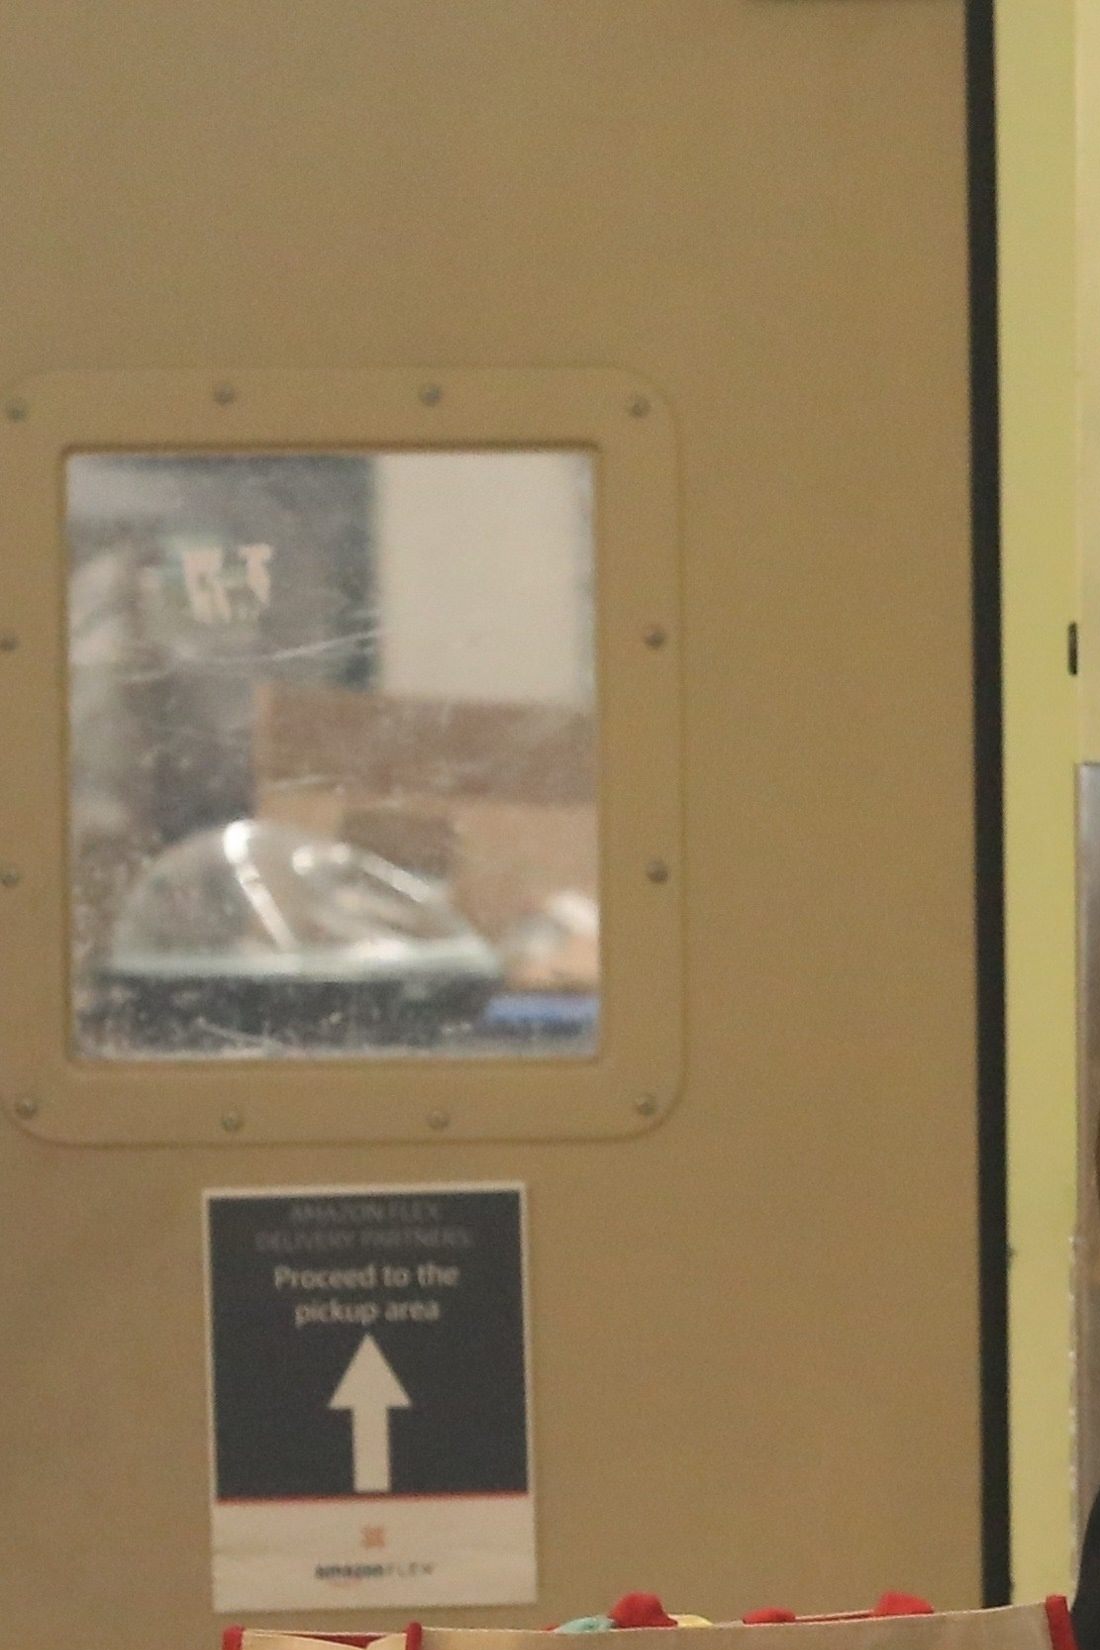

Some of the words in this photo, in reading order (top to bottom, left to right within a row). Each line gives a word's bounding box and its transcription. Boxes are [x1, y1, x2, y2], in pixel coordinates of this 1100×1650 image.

[274, 1264, 376, 1290] Proceed
[382, 1264, 410, 1288] to
[417, 1262, 461, 1287] the
[294, 1299, 379, 1327] pickup
[385, 1301, 440, 1322] area
